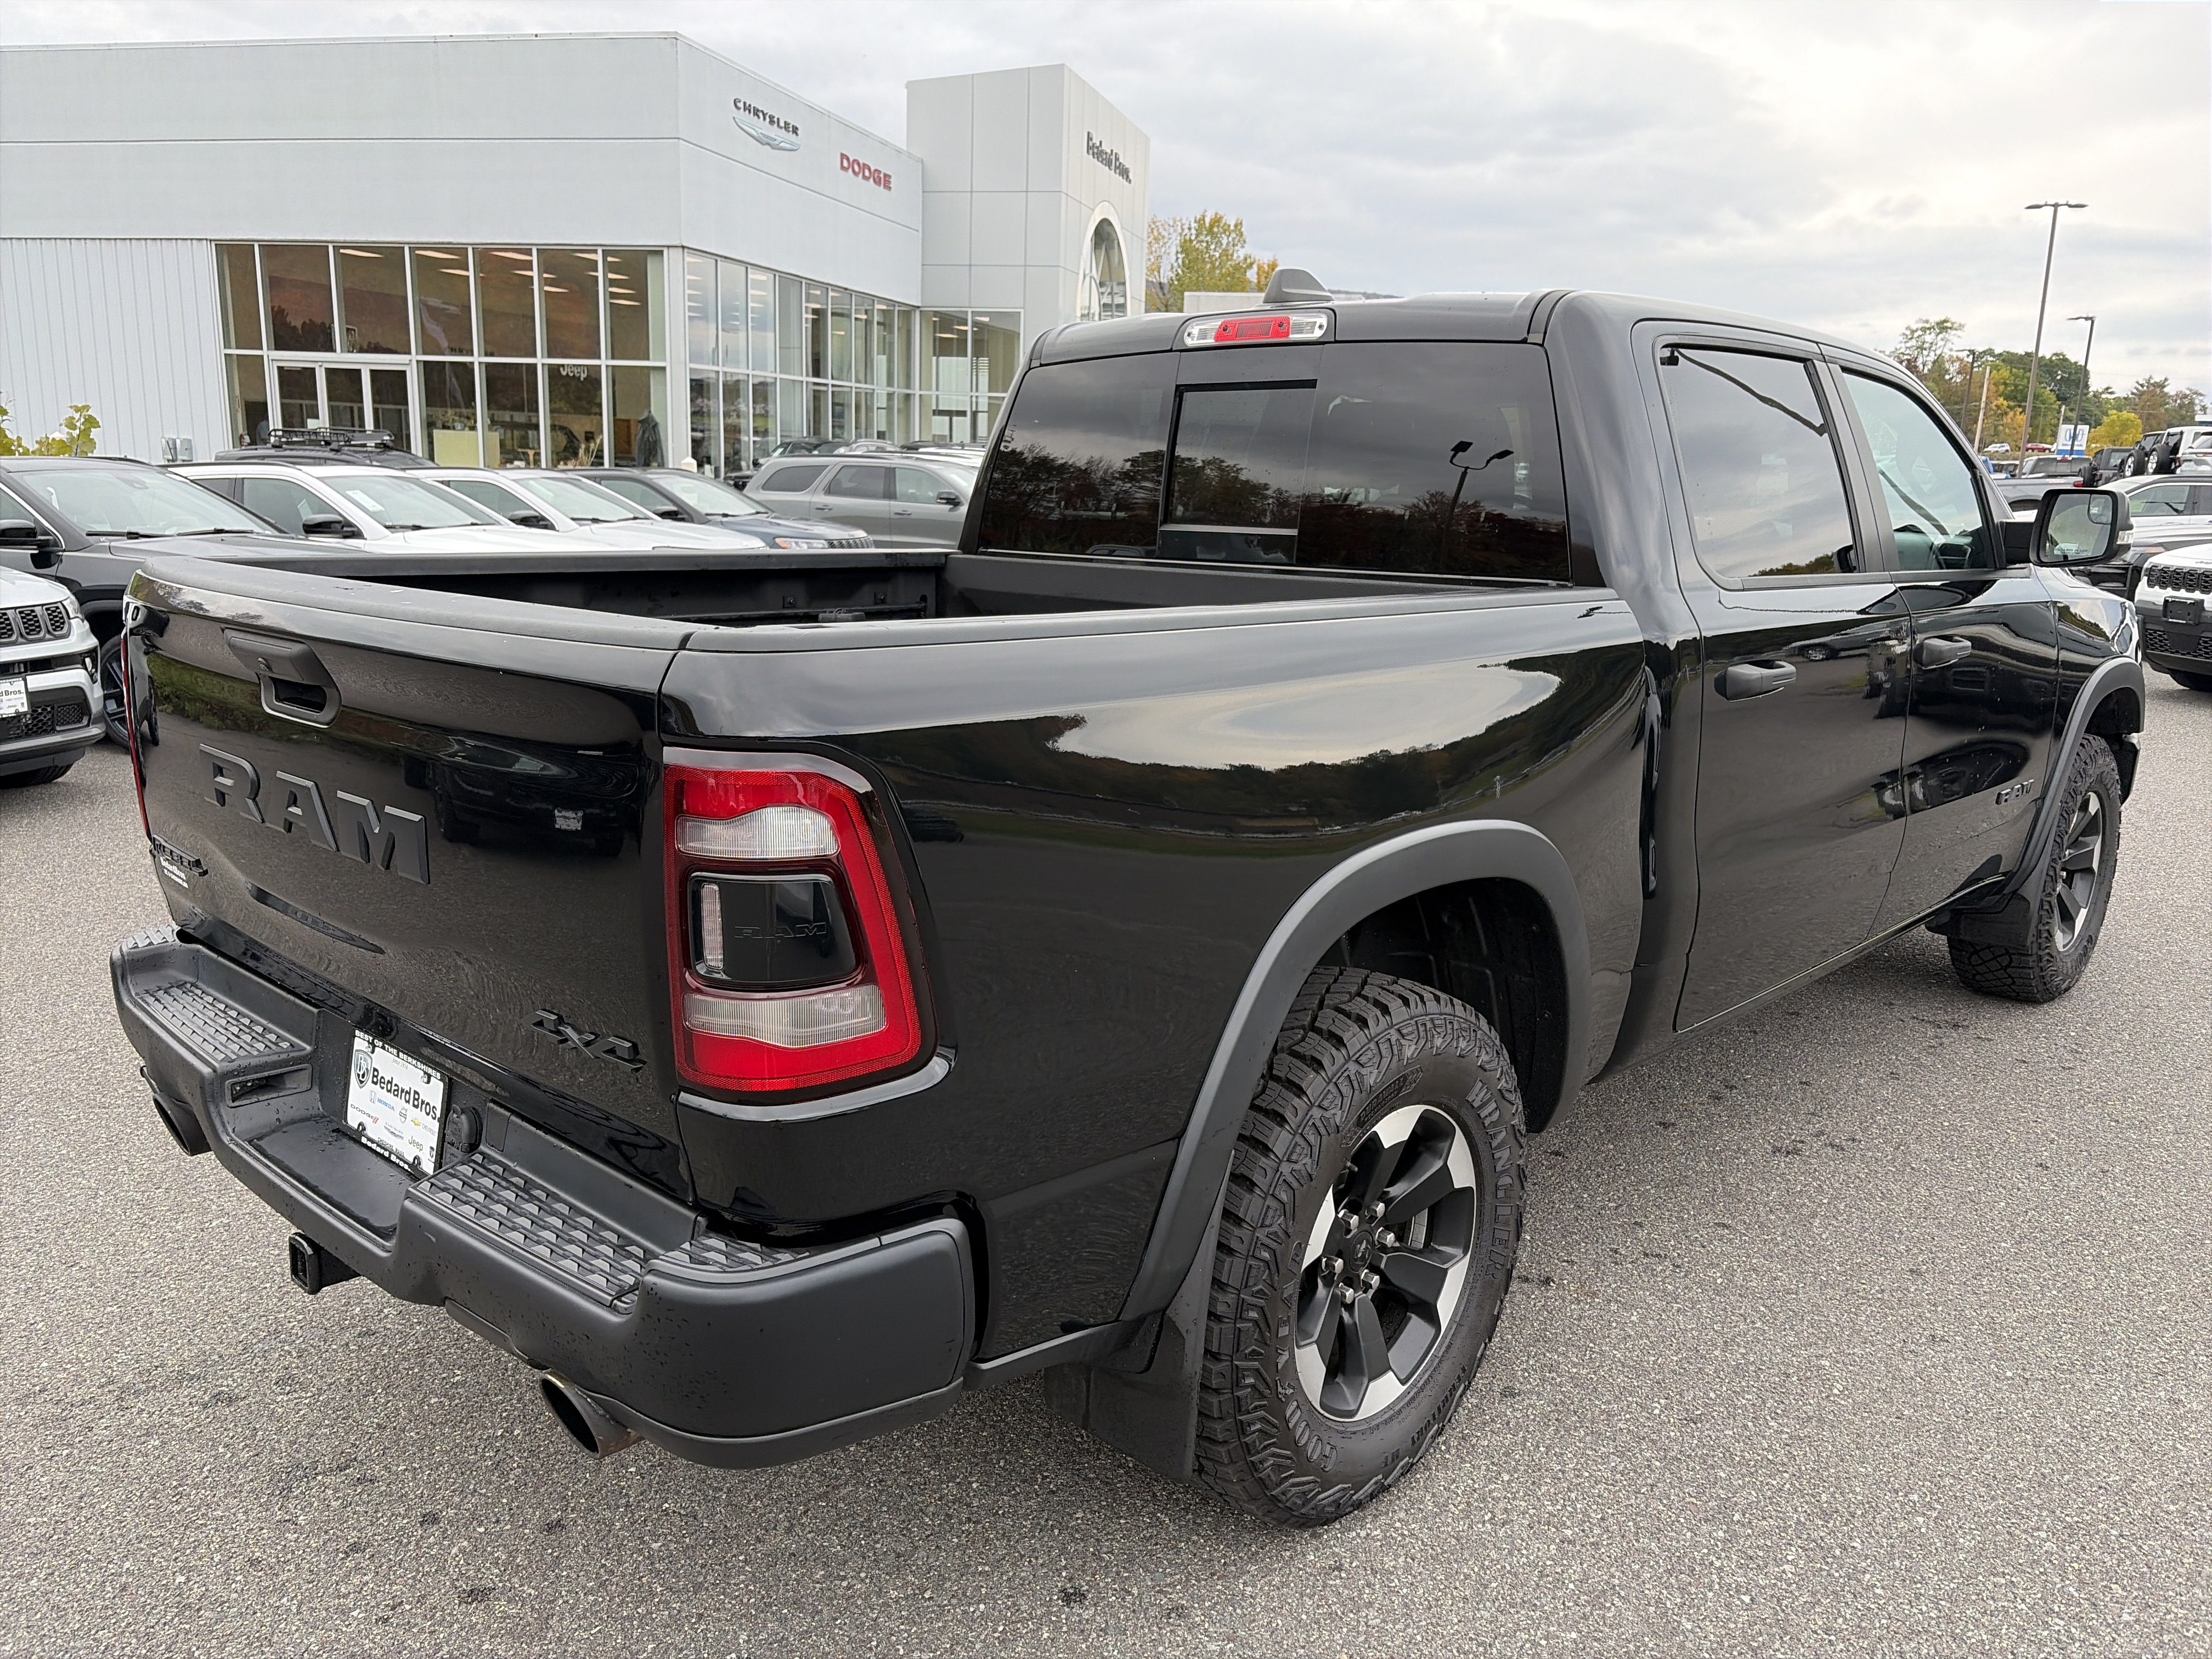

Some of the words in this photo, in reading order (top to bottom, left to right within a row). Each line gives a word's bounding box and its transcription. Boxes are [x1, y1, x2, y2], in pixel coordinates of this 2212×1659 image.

[733, 98, 799, 136] CHRYSLER
[1087, 131, 1113, 171] Bedard
[840, 152, 892, 191] DODGE
[560, 364, 588, 381] Jeep
[1995, 779, 2035, 805] RAM
[199, 743, 431, 884] RAM
[734, 922, 826, 938] RAM
[356, 1029, 373, 1042] BEST
[374, 1039, 383, 1047] OF
[384, 1043, 398, 1056] THE
[399, 1052, 441, 1079] BERKSHIRES
[371, 1067, 411, 1105] Bedard
[412, 1090, 440, 1122] Bros.
[377, 1098, 395, 1111] HONDA
[362, 1136, 389, 1158] Bedard
[391, 1154, 411, 1171] Bros.
[408, 1135, 424, 1152] Jeep
[1465, 1078, 1514, 1279] WRANGLER
[1411, 1363, 1466, 1447] TERRITORY
